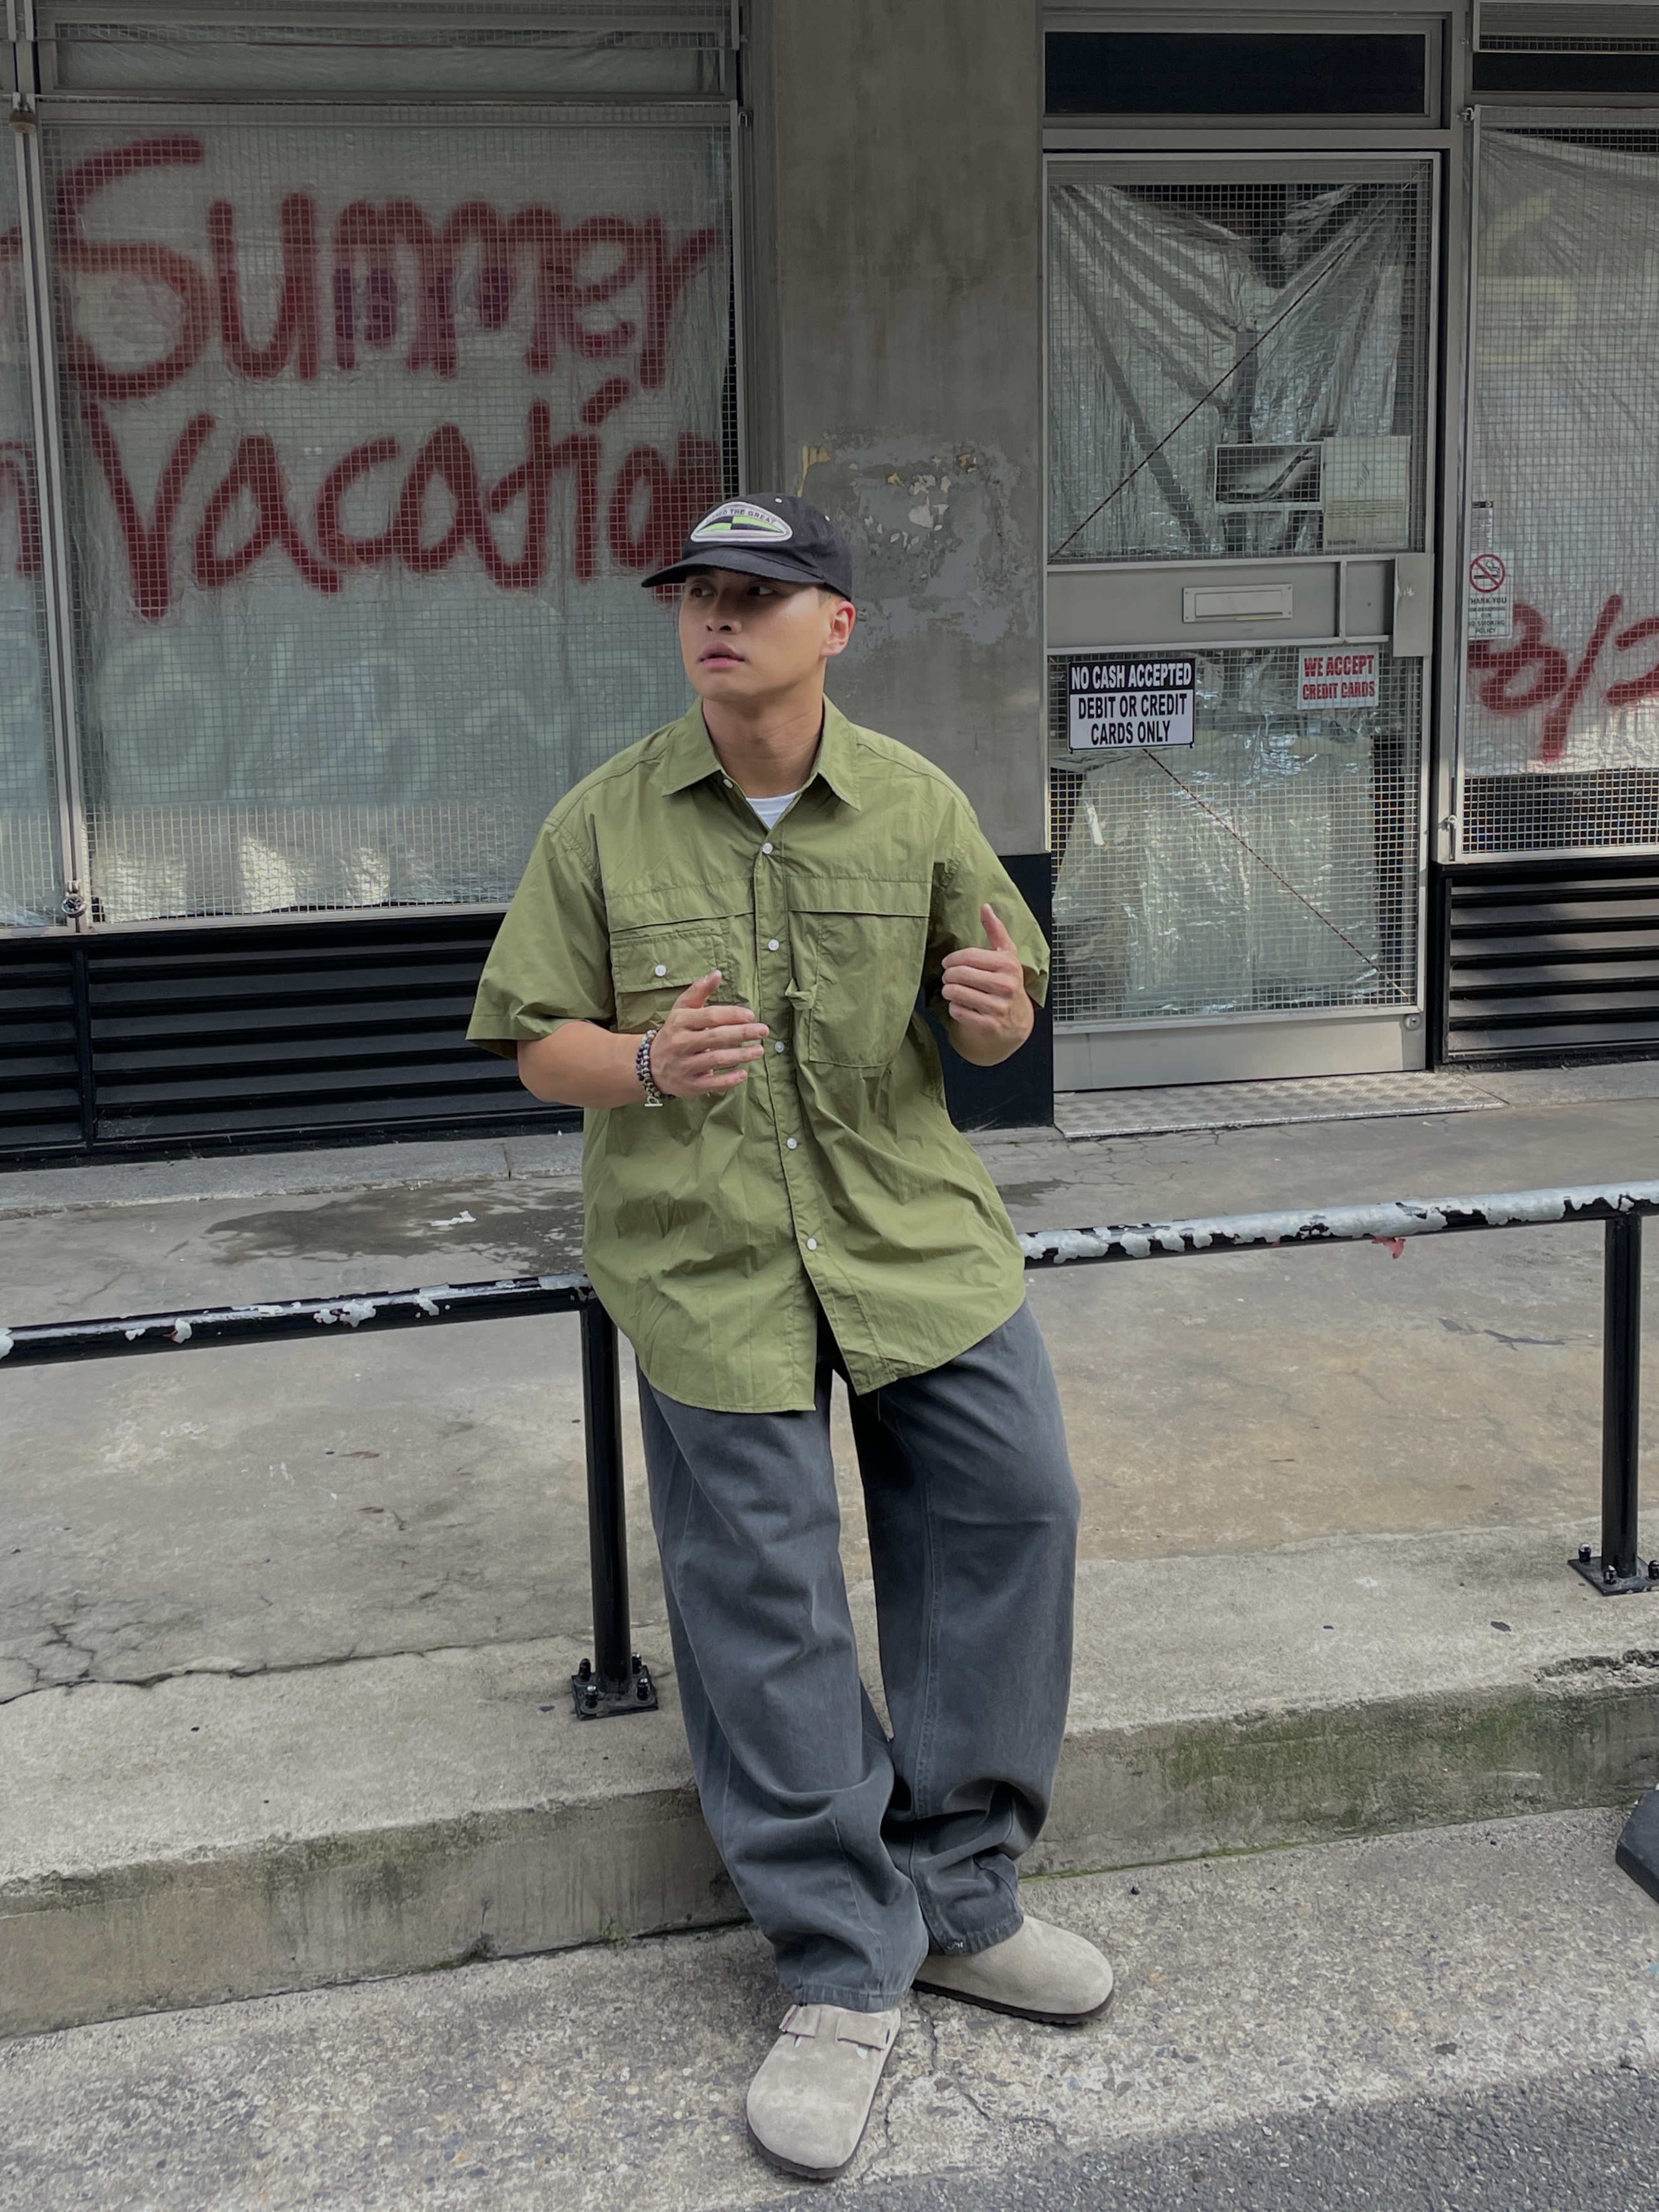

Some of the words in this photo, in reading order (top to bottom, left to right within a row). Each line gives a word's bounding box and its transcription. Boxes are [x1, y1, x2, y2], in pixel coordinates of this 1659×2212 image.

[1071, 666, 1090, 690] NO
[1092, 665, 1125, 689] CASH
[1128, 662, 1192, 688] ACCEPTED
[1304, 657, 1324, 677] WE
[1325, 655, 1374, 676] ACCEPT
[1302, 683, 1339, 700] CREDIT
[1341, 681, 1375, 698] CARDS
[1078, 696, 1116, 720] DEBIT
[1119, 695, 1137, 718] OR
[1141, 693, 1187, 716] CREDIT
[1091, 721, 1133, 745] CARDS
[1137, 720, 1170, 743] ONLY
